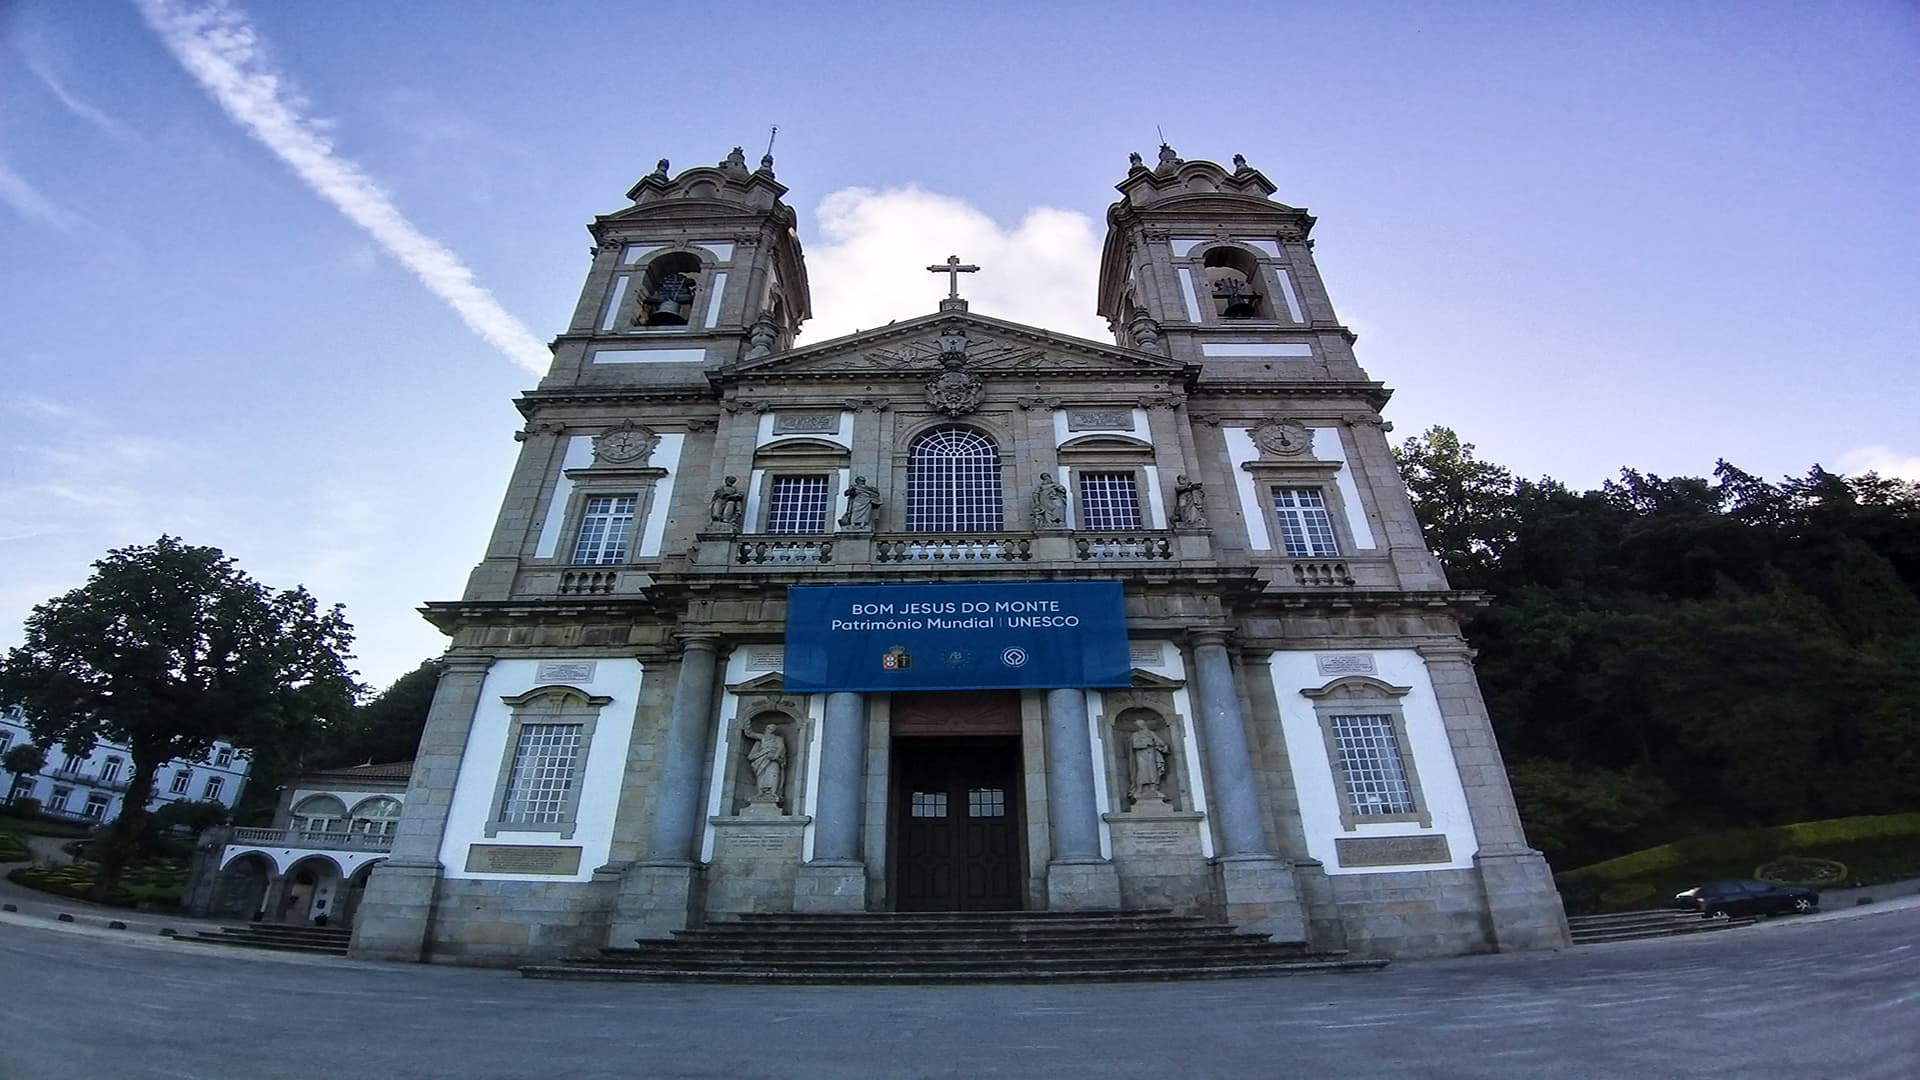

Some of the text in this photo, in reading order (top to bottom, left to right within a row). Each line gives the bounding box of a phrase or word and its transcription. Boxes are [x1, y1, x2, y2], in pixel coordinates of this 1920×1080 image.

[852, 601, 1060, 615] BOM JESUS DO MONTE
[831, 616, 1080, 631] Património Mundial UNESCO
